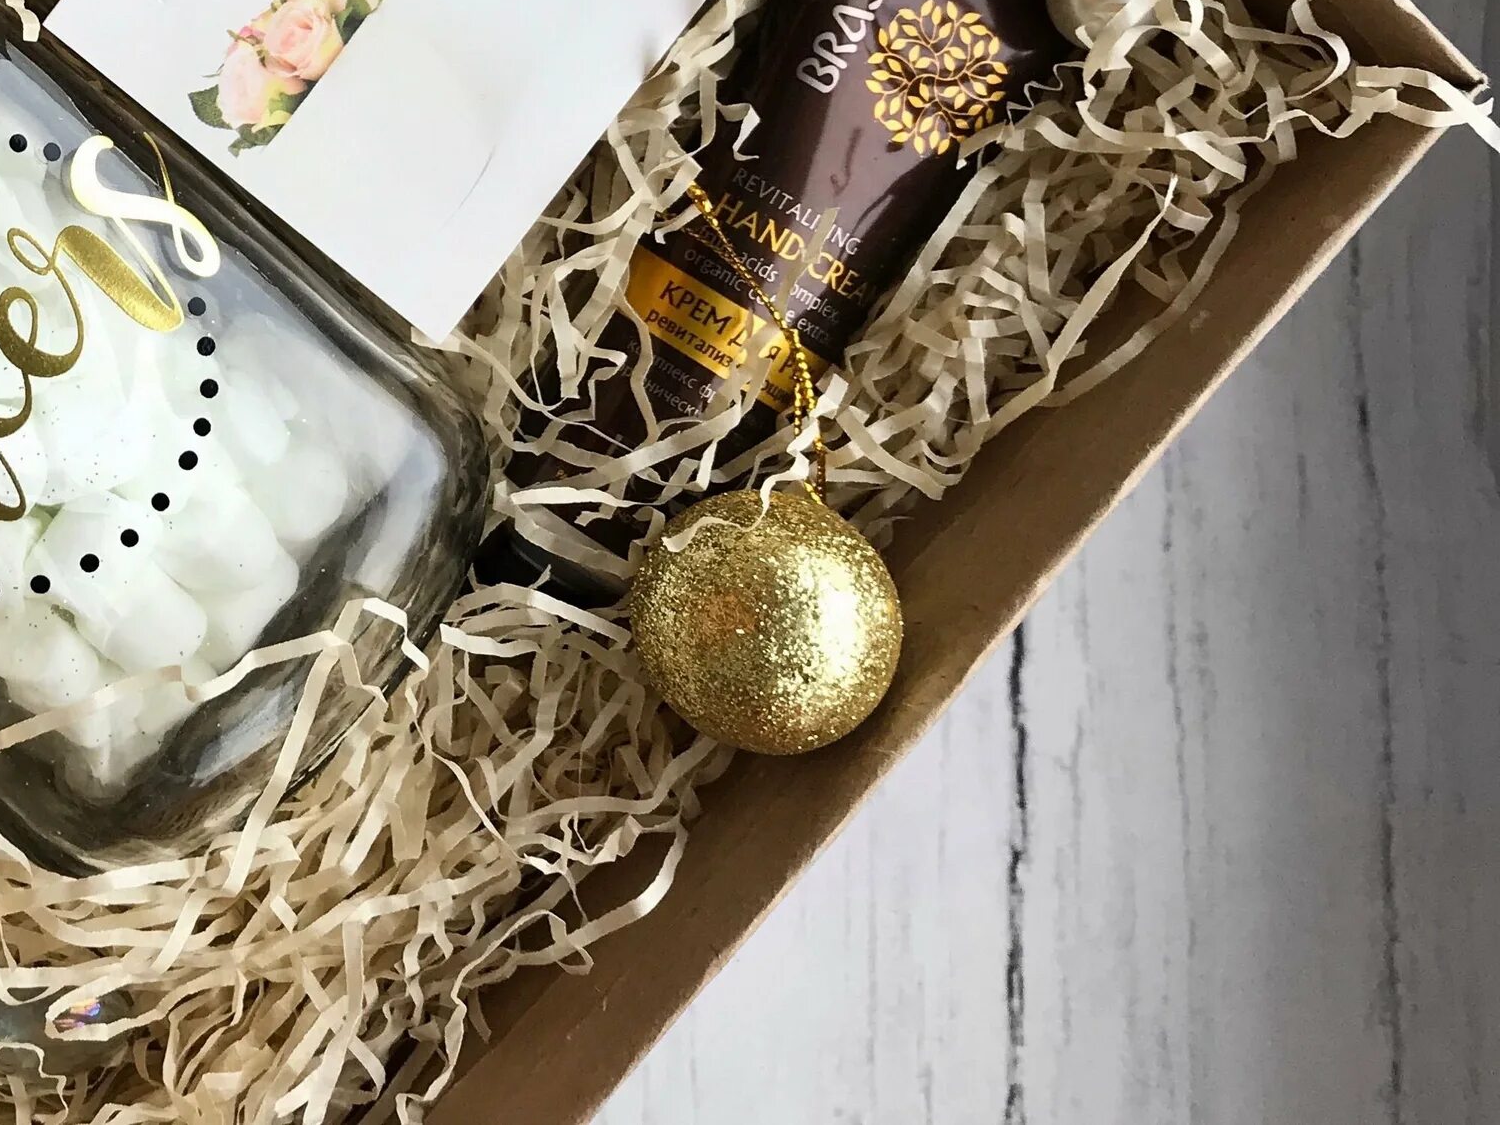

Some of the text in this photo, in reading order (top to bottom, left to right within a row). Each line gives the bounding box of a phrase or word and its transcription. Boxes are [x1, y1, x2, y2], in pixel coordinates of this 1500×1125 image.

[731, 167, 863, 256] REVITALIING
[683, 248, 746, 293] organic
[713, 191, 872, 303] HAND CREA
[739, 250, 778, 284] acids
[659, 279, 733, 335] КРЕМ
